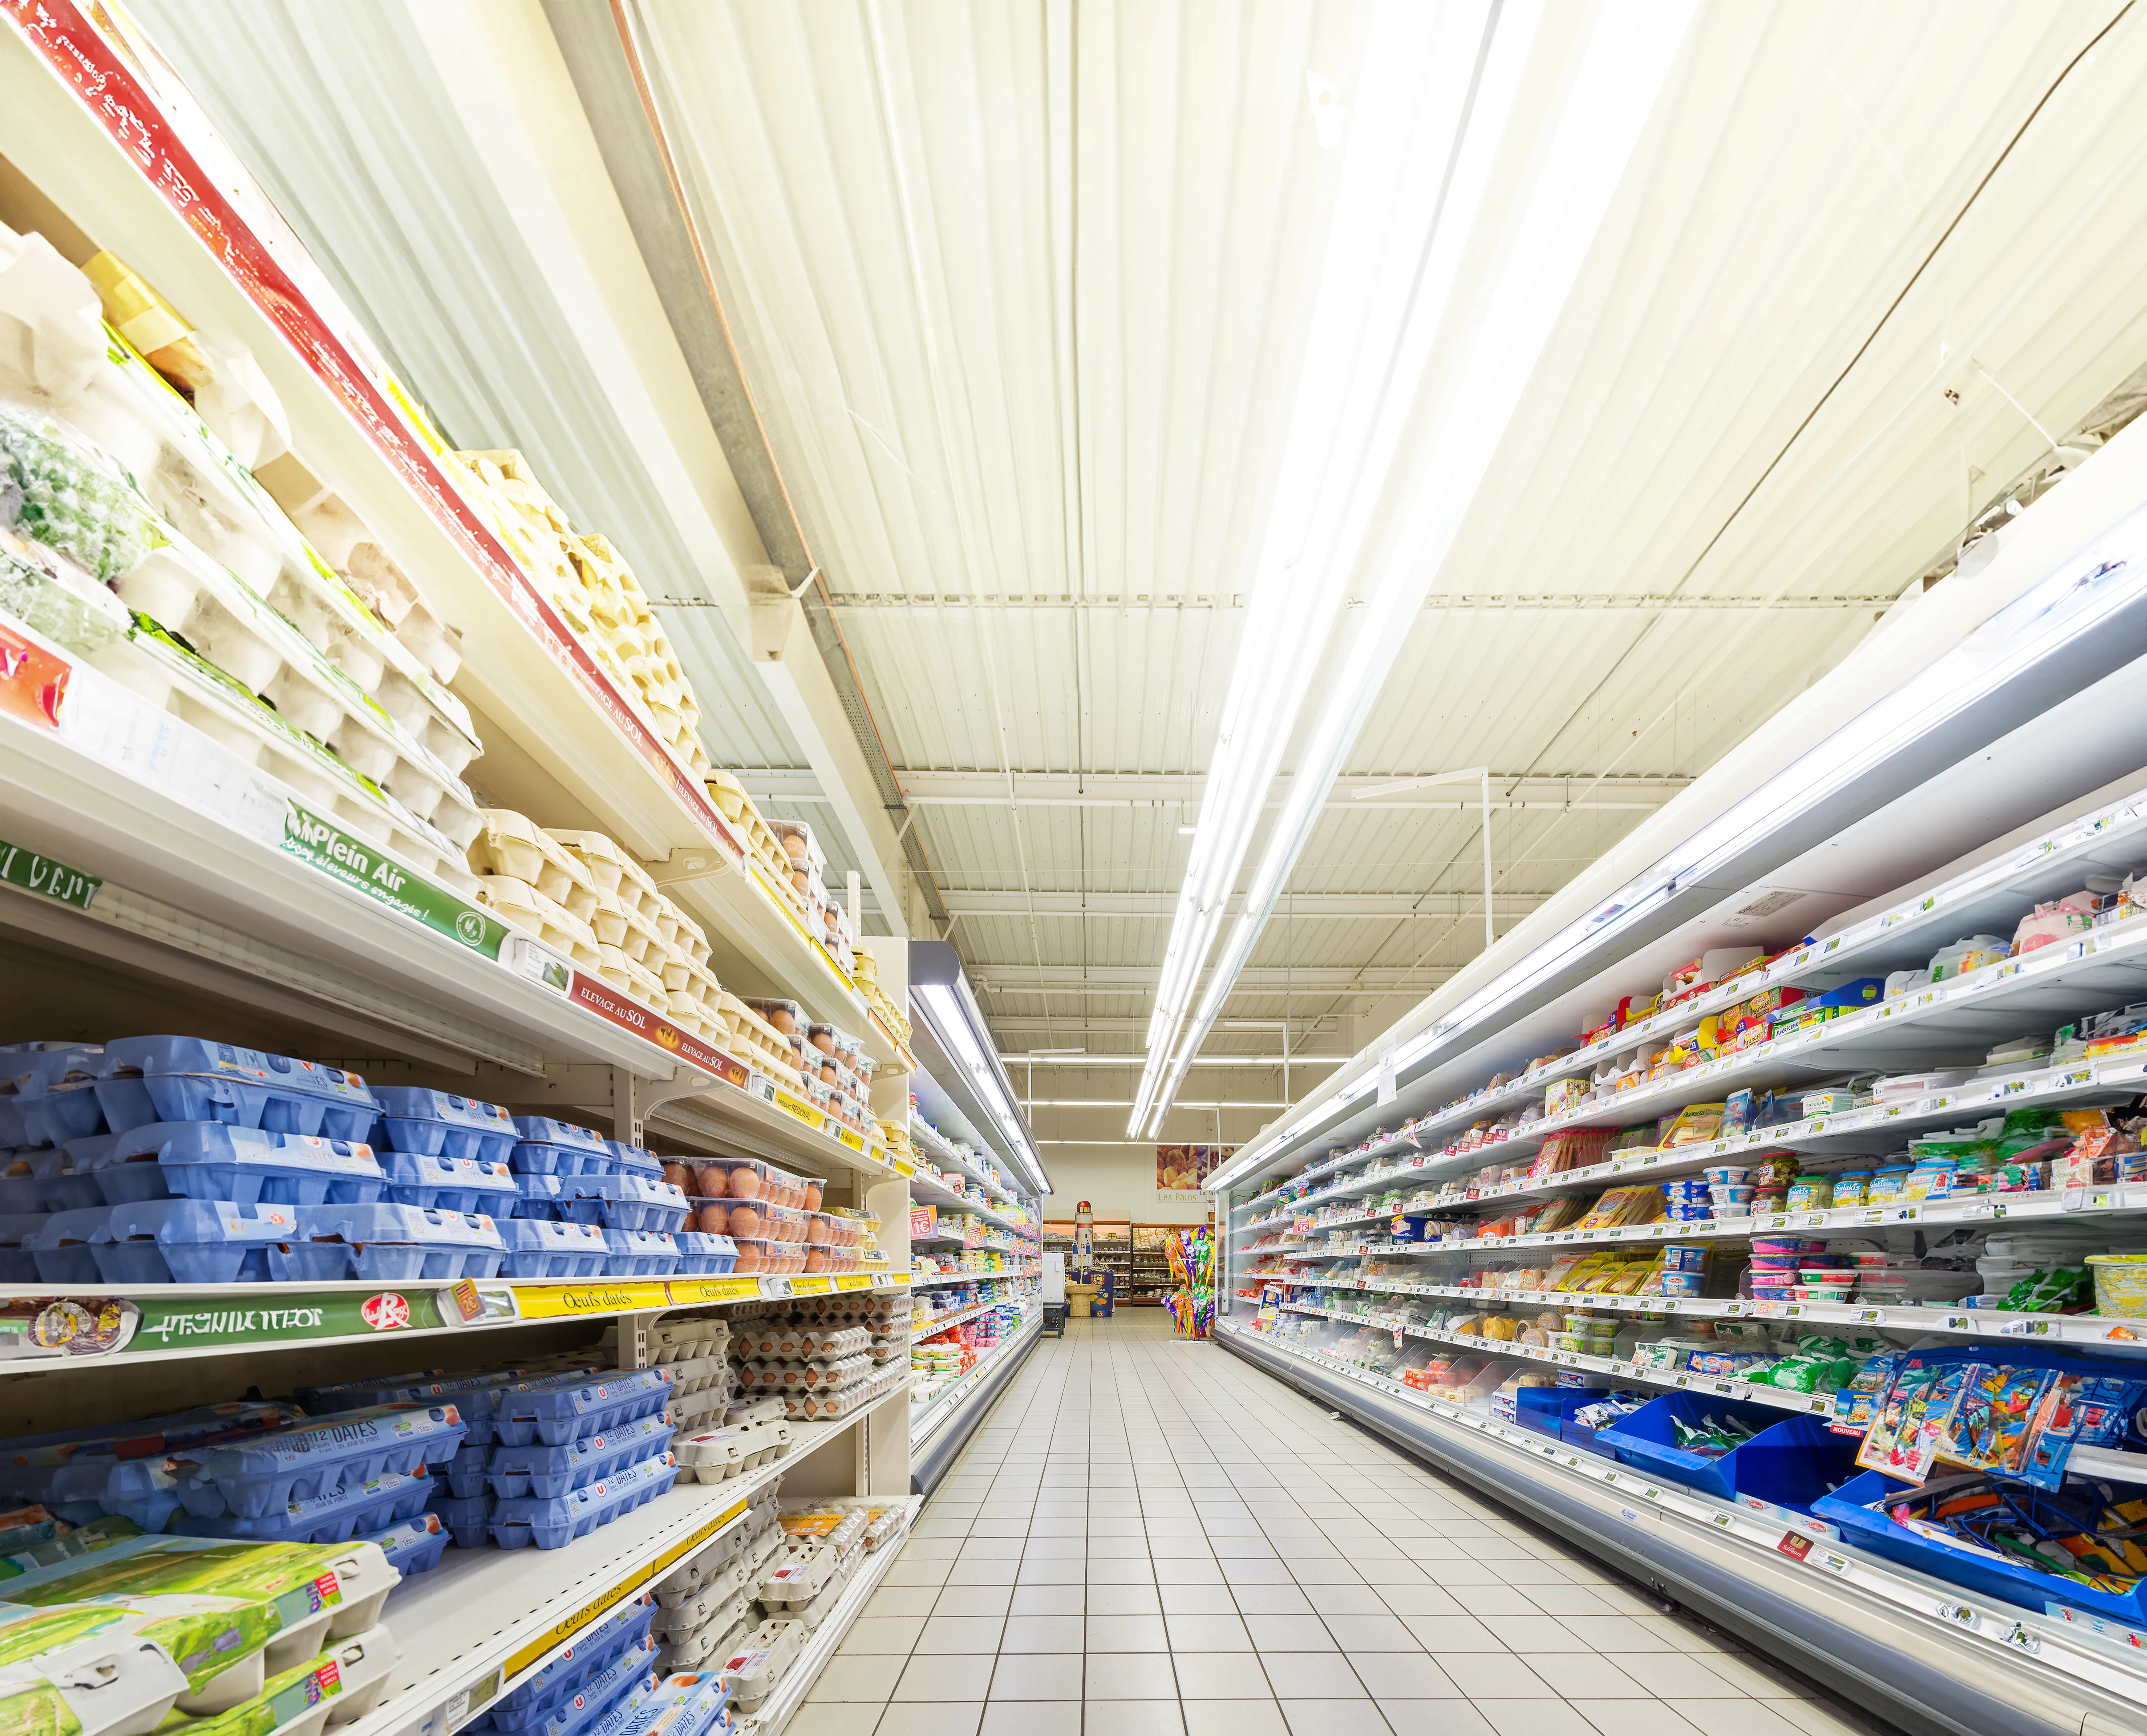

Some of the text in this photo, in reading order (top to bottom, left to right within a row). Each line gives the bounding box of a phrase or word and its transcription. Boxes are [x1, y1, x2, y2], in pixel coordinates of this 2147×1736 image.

[613, 707, 643, 747] AU SOL
[678, 783, 718, 837] ELEVAGE AU SOL
[313, 824, 369, 874] Plein
[372, 862, 406, 892] Air
[316, 855, 370, 889] éleveurs
[371, 886, 421, 917] engagés
[1752, 996, 1768, 1006] PRÉSIDENT
[581, 987, 646, 1029] ELEVAGE AU SOL
[1753, 999, 1770, 1015] BURGER
[1724, 1013, 1739, 1025] BURGER
[1745, 1033, 1762, 1046] BURGER
[681, 1042, 723, 1071] ELEVAGE AU SOL
[468, 1098, 476, 1108] U
[778, 1098, 811, 1120] PRODUIT RÉGIONAL
[845, 1133, 853, 1145] datés
[913, 1221, 930, 1234] 1€
[970, 1235, 982, 1244] 2€
[721, 1284, 739, 1296] datés
[808, 1282, 818, 1290] datés
[602, 1291, 632, 1305] datés
[463, 1296, 477, 1313] 2€
[432, 1386, 441, 1394] U
[607, 1382, 616, 1391] 12
[599, 1389, 606, 1397] U
[1833, 1426, 1861, 1436] NOUVEAU
[365, 1435, 381, 1444] PONTE
[597, 1485, 604, 1494] U
[334, 1494, 349, 1503] PONTE
[1749, 1500, 1763, 1509] Galbani
[1809, 1522, 1825, 1531] Galbani
[1790, 1535, 1807, 1549] U
[1782, 1544, 1802, 1557] Saveurs
[320, 1579, 336, 1590] MOYEN
[323, 1586, 336, 1595] GROS
[564, 1648, 572, 1659] U
[320, 1669, 338, 1681] MOYEN
[324, 1676, 337, 1686] GROS
[584, 1684, 594, 1693] 12
[575, 1697, 583, 1707] U
